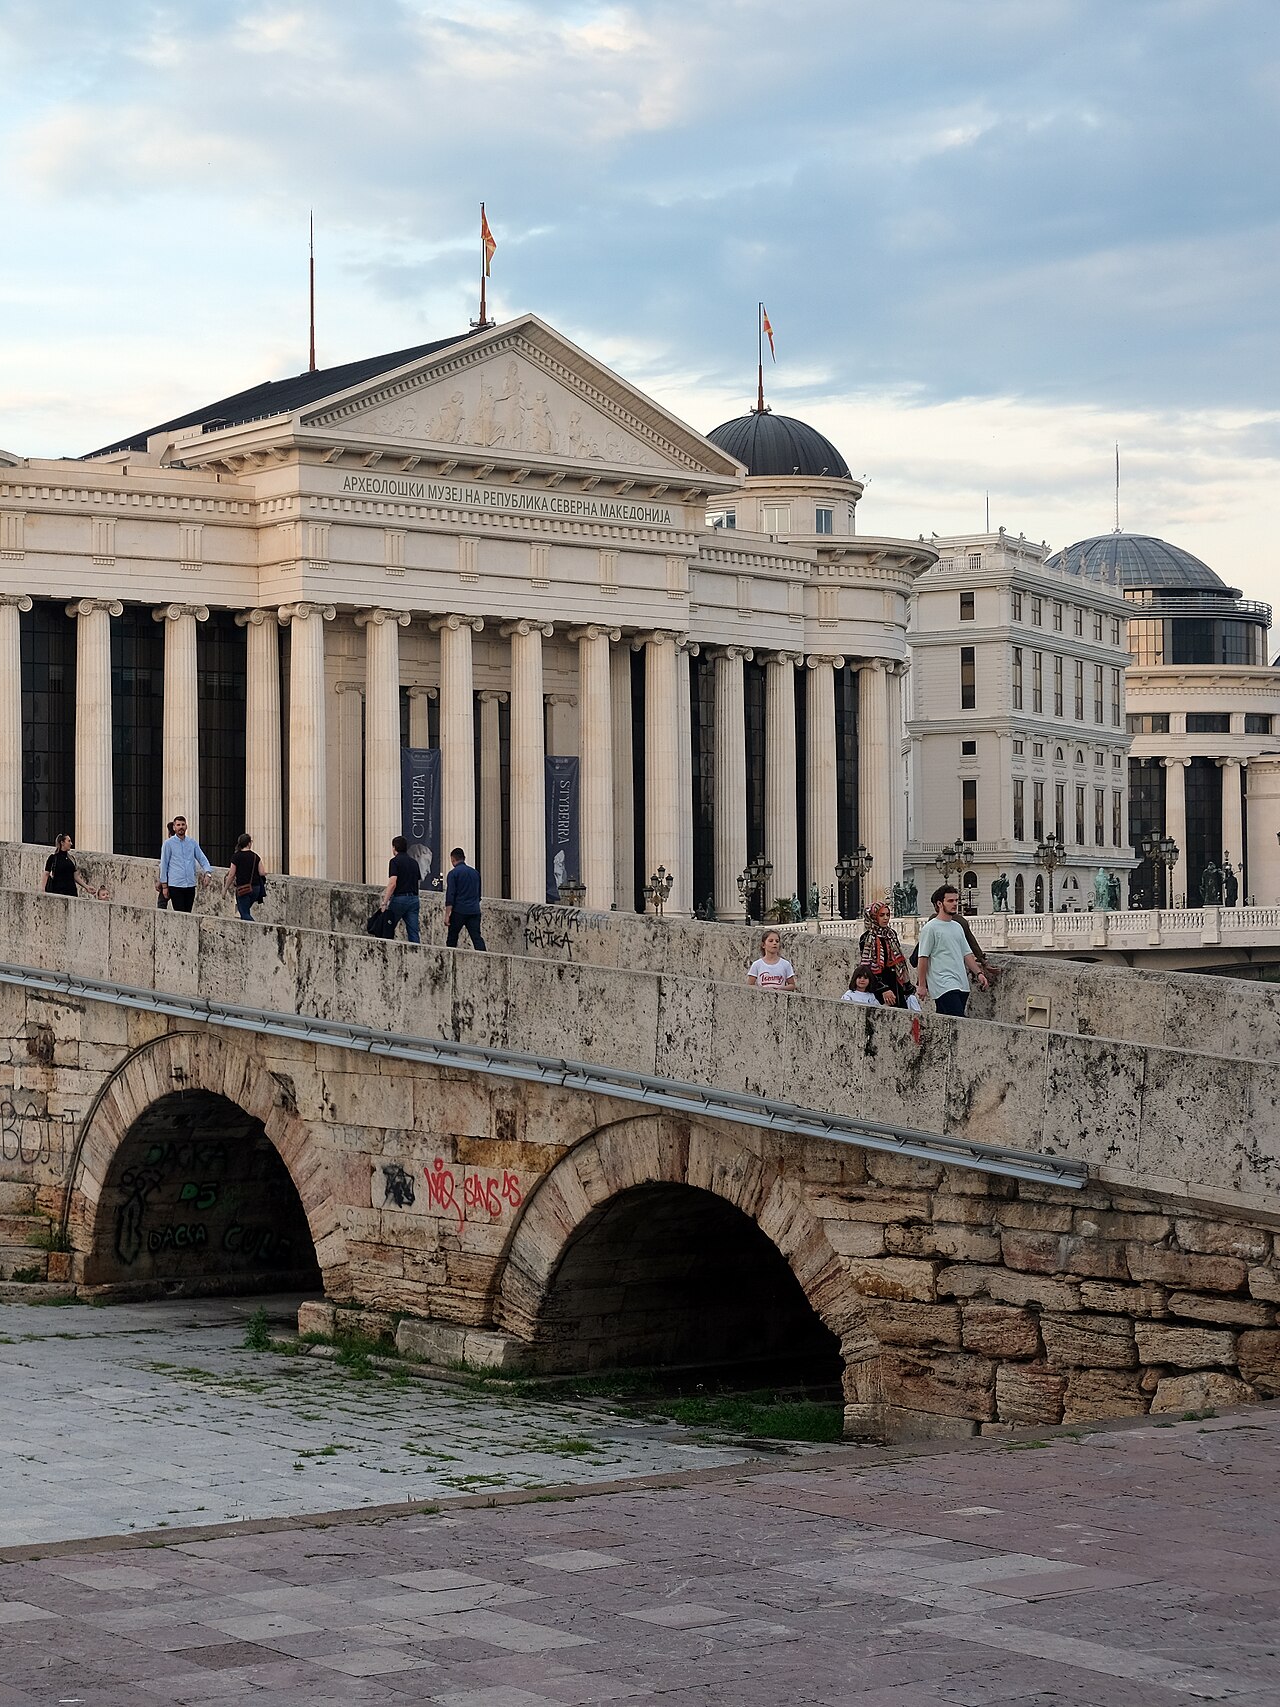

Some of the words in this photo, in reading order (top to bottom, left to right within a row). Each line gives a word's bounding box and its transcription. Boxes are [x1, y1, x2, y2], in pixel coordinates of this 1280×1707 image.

[343, 475, 425, 499] АРХЕОЛОШКИ
[427, 484, 464, 503] МУЗЕЈ
[465, 489, 481, 505] НА
[483, 492, 549, 512] РЕПУБЛИКА
[550, 498, 599, 517] СЕВЕРНА
[600, 503, 672, 525] МАКЕДОНИЈА
[411, 773, 426, 840] СТИБЕРА
[557, 779, 572, 845] STYBERRA
